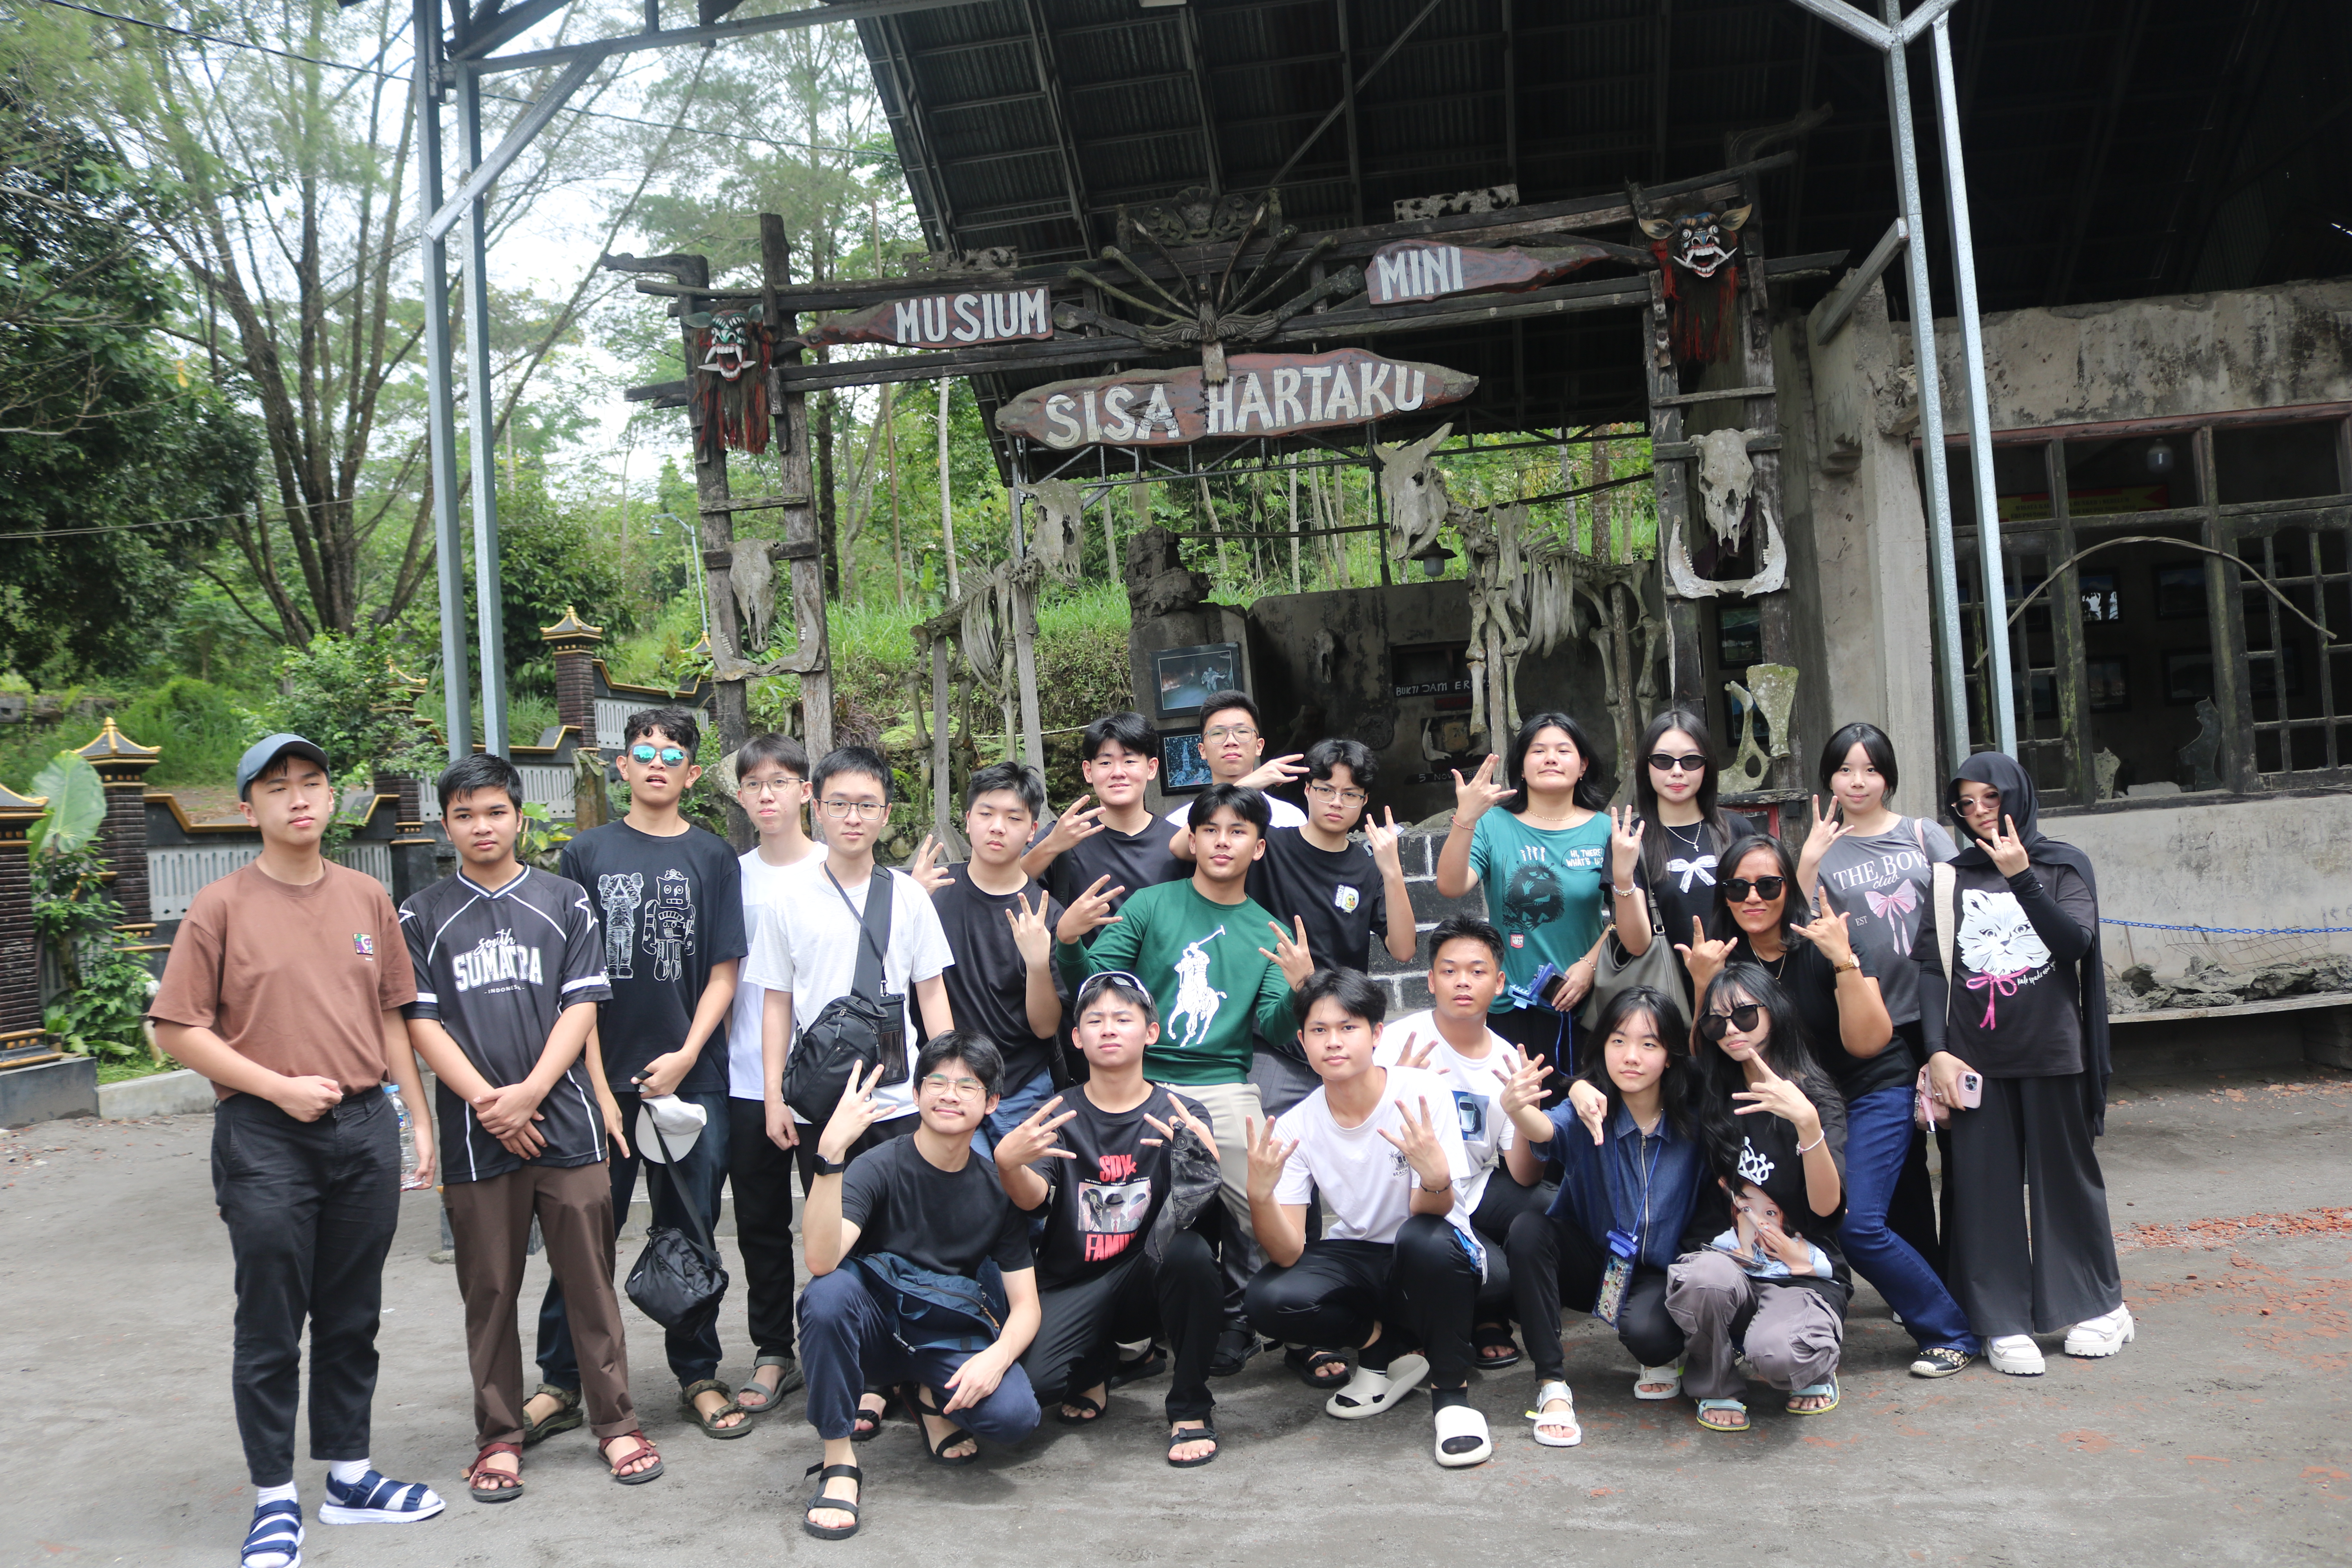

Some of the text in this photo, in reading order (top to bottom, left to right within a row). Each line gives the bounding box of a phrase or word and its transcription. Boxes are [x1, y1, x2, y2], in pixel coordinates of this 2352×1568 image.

[1377, 246, 1463, 301] MINI
[895, 289, 1046, 344] MUSIUM
[1045, 362, 1425, 448] SISA HARTAKU
[1396, 684, 1419, 697] BUKTI
[1419, 773, 1426, 782] 5
[1566, 857, 1591, 867] WHAT'S
[1570, 848, 1602, 858] HI, THERE!
[1833, 860, 1879, 891] THE
[1873, 871, 1900, 889] club
[1855, 915, 1868, 926] EST
[473, 927, 516, 956] south
[452, 944, 544, 992] SUMATRA
